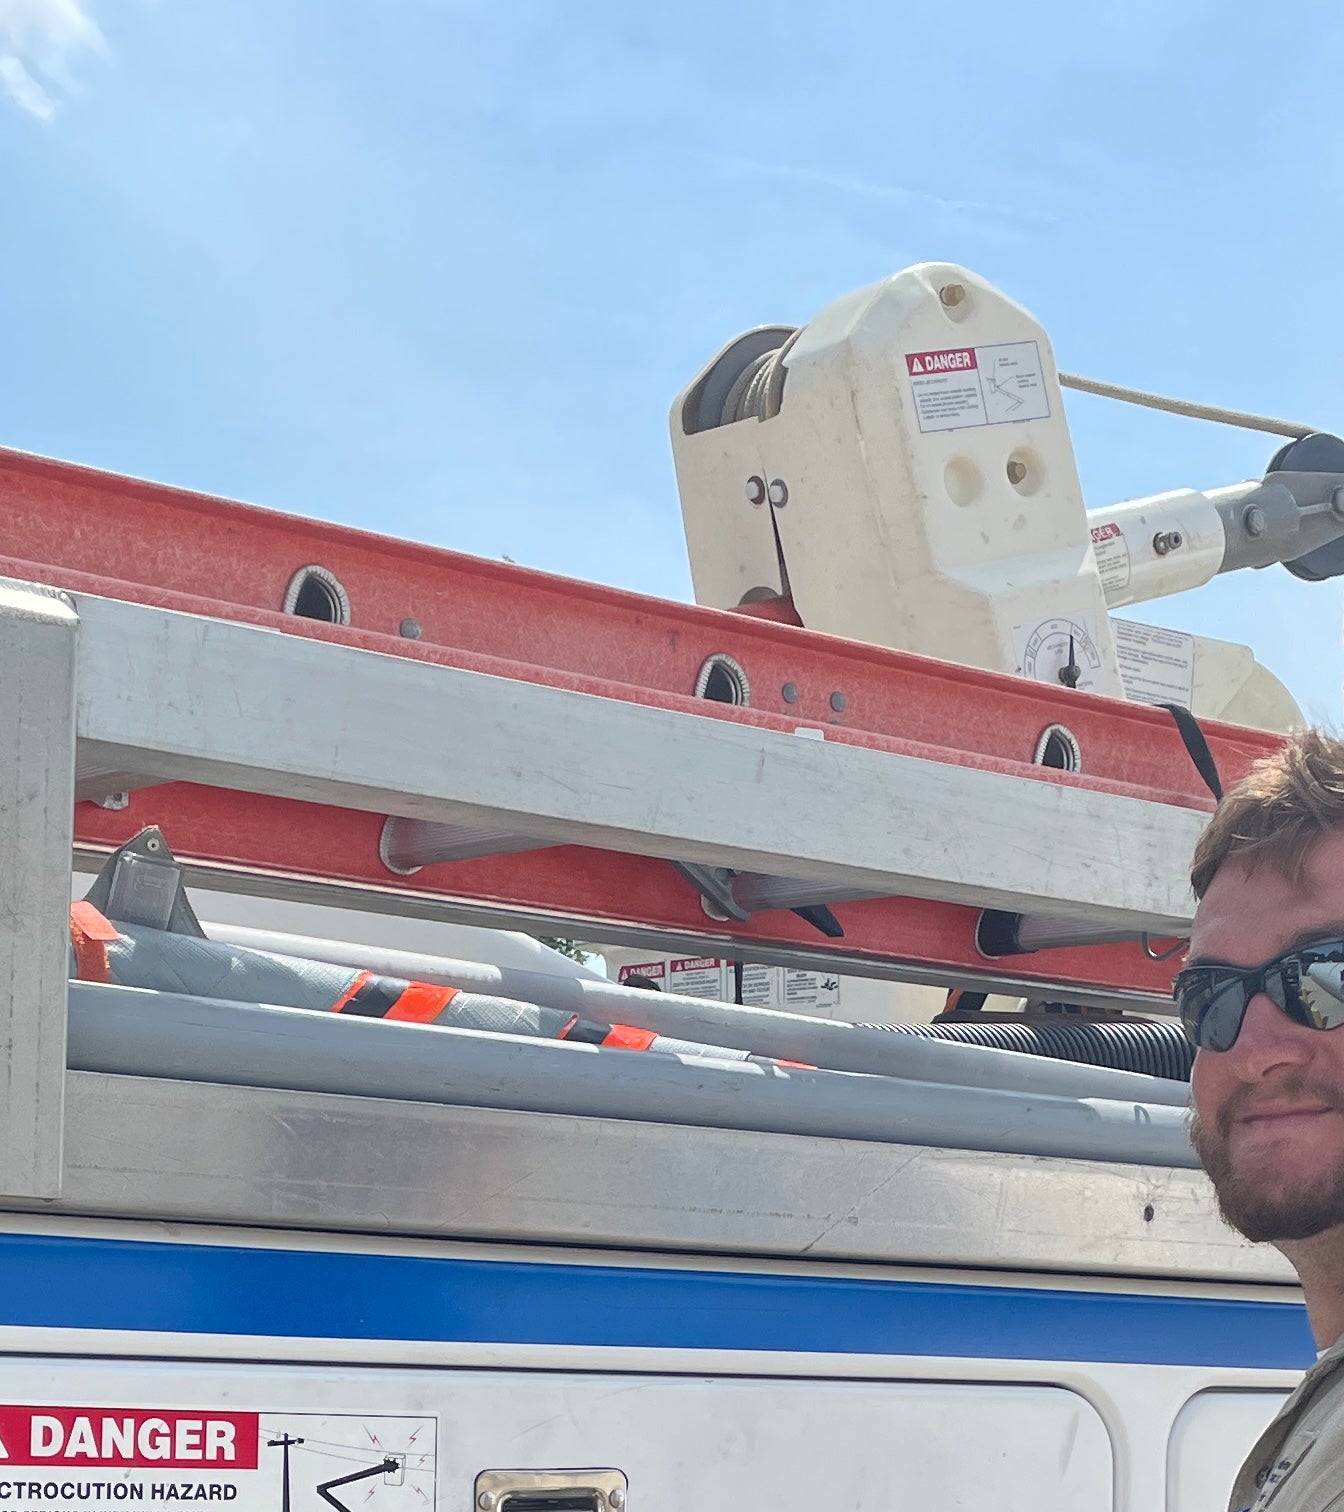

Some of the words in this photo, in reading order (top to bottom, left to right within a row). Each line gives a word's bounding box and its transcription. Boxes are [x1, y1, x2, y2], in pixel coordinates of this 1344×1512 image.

[924, 352, 971, 371] DANGER
[31, 1415, 236, 1461] DANGER
[151, 1483, 237, 1500] HAZARD
